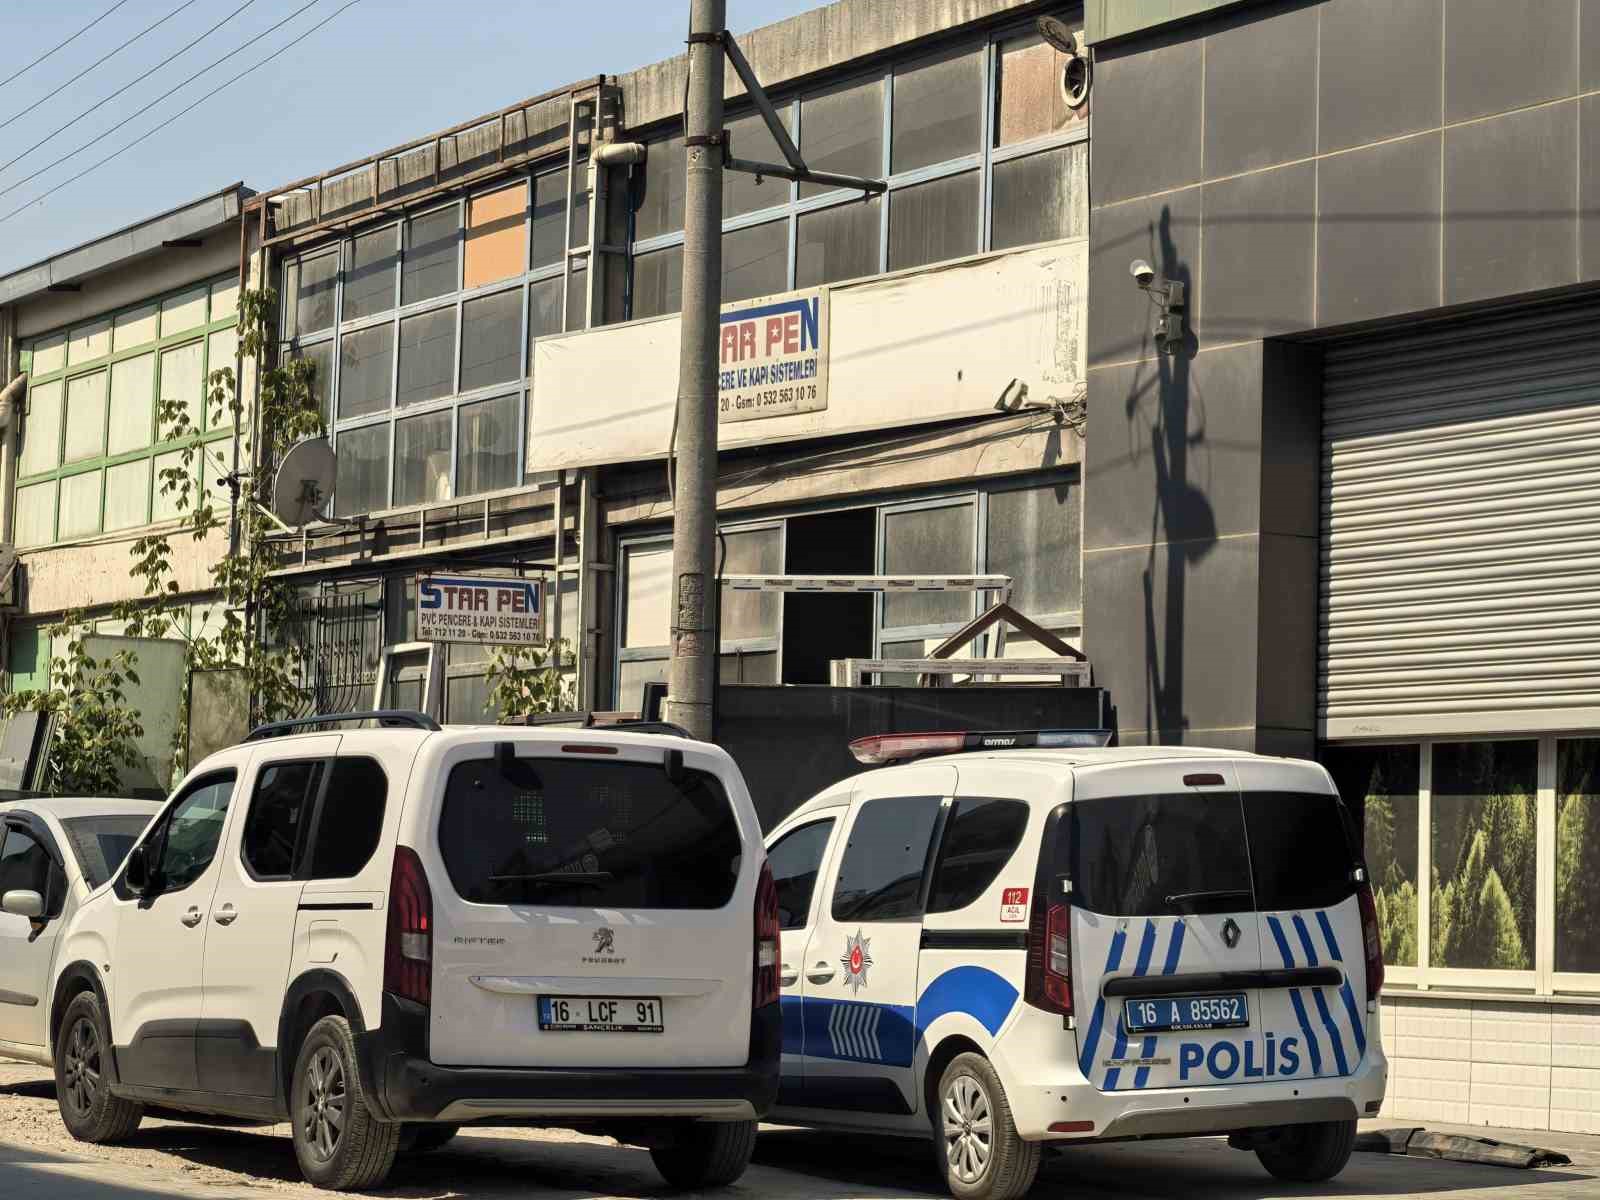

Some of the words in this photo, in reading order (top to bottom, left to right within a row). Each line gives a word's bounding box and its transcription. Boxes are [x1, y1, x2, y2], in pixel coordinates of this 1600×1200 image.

[719, 321, 756, 364] AR
[765, 296, 819, 357] PEN
[719, 370, 735, 391] ERE
[737, 368, 748, 388] VE
[721, 397, 729, 412] 20
[736, 395, 755, 409] Gsm:
[756, 393, 761, 407] 0
[763, 390, 777, 405] 532
[779, 388, 793, 403] 563
[795, 386, 805, 401] 10
[807, 385, 817, 399] 76
[421, 578, 489, 611] STAR
[497, 583, 540, 613] PEN
[421, 613, 437, 625] PVC
[439, 614, 471, 627] PENCERE
[480, 616, 497, 628] KAPI
[434, 627, 447, 637] 712
[1007, 890, 1022, 904] 112
[552, 1000, 569, 1022] 16
[588, 1000, 618, 1023] LCF
[636, 1002, 655, 1023] 91
[1138, 1002, 1157, 1024] 16
[1171, 1001, 1181, 1023] A
[1190, 998, 1241, 1021] 85562
[1179, 1032, 1299, 1081] POLİS
